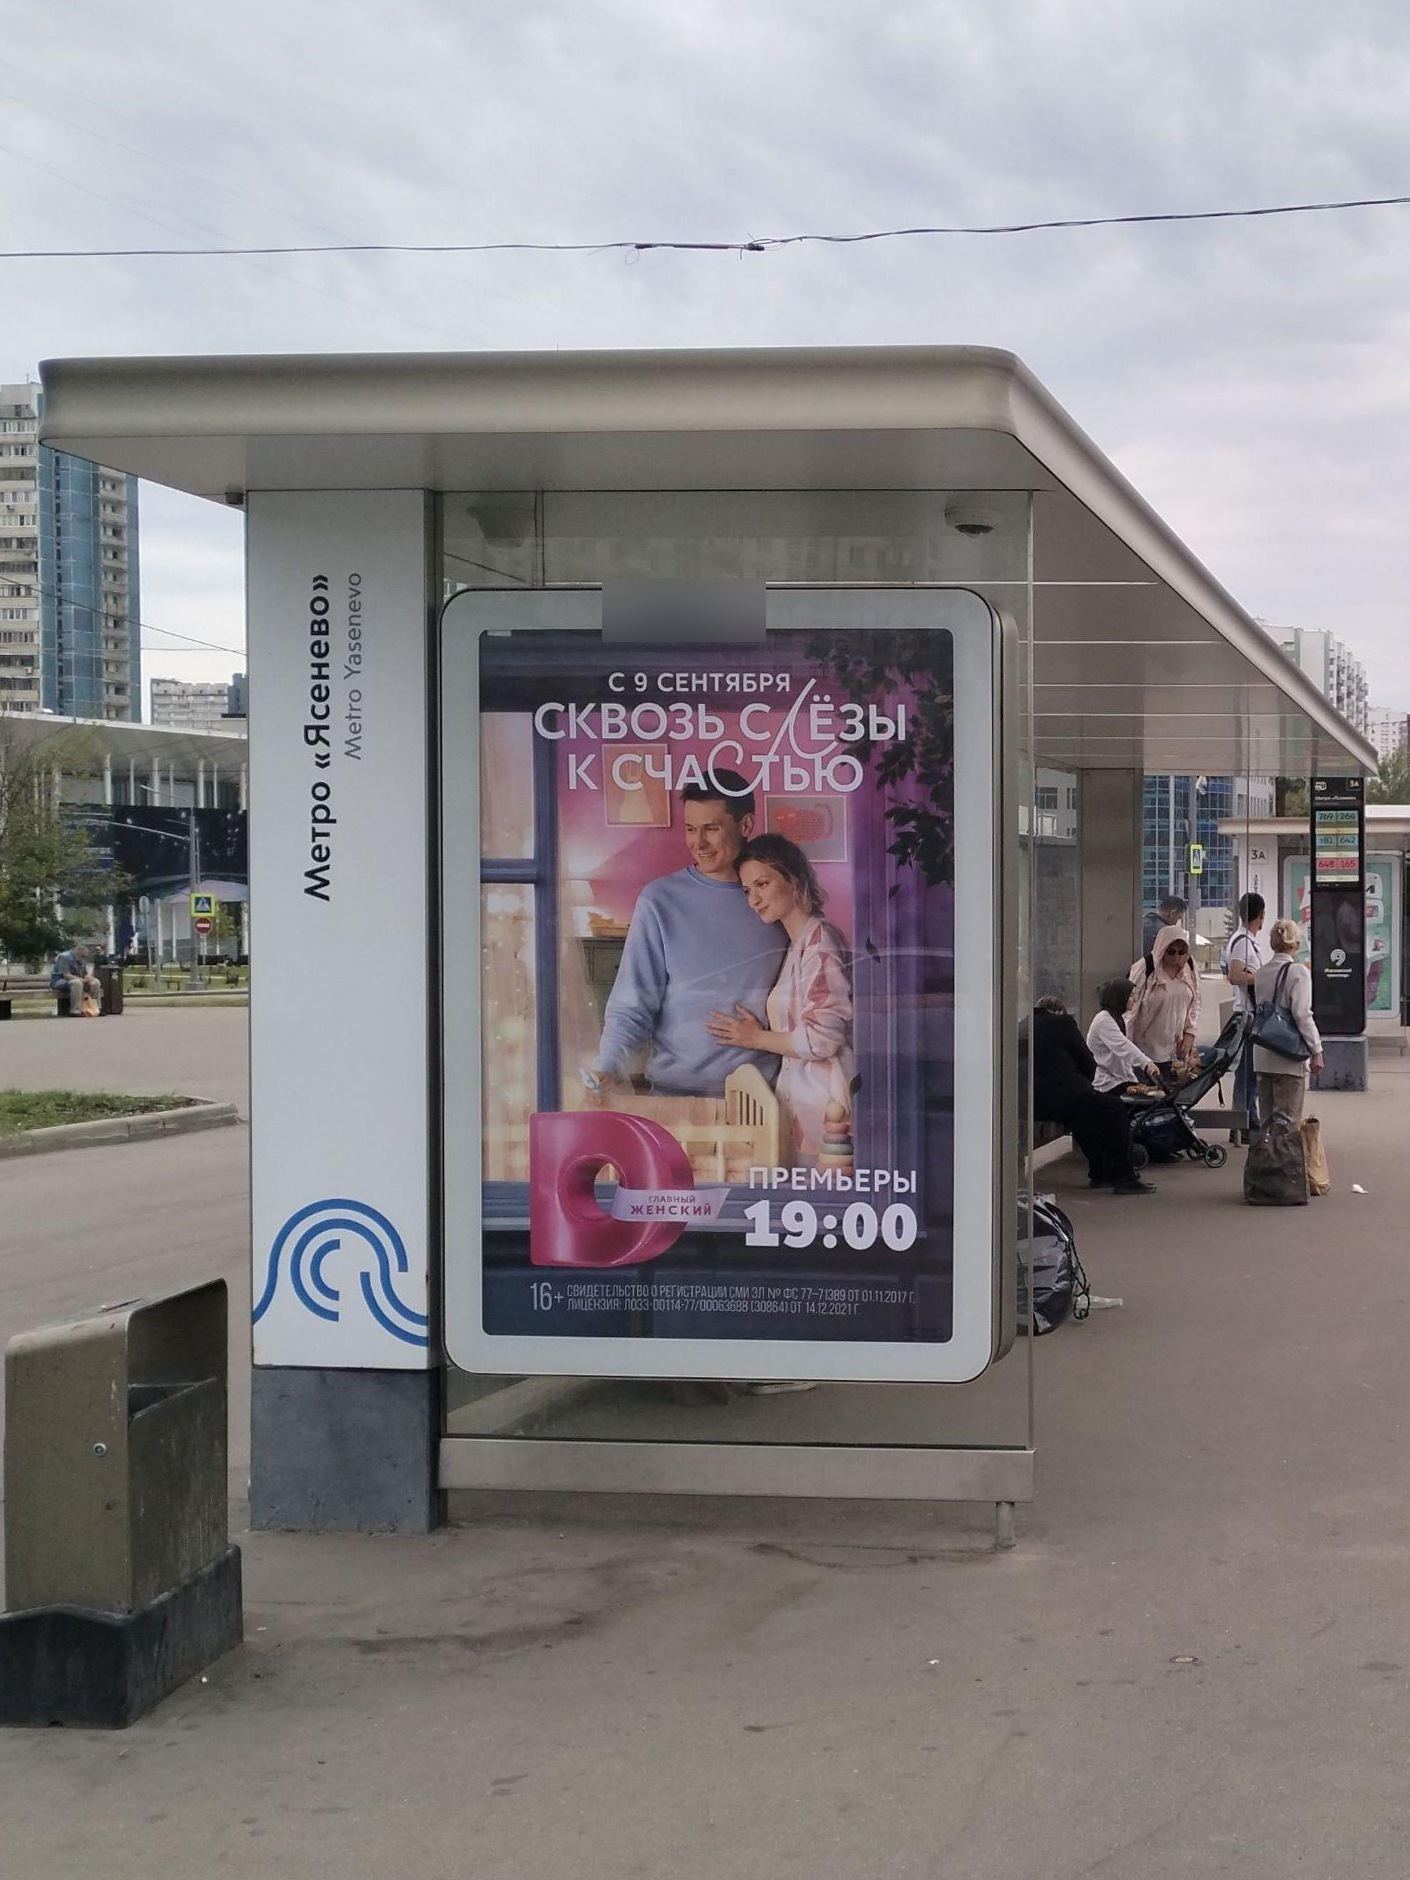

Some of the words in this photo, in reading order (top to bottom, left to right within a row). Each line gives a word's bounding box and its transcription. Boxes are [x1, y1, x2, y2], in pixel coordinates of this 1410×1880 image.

[344, 573, 362, 680] Yasenevo
[304, 574, 331, 769] «Ясенево»
[608, 672, 625, 693] С
[634, 672, 648, 692] 9
[657, 672, 791, 693] СЕНТЯБРЯ
[344, 689, 362, 760] Metro
[534, 702, 725, 740] СКВОЗЬ
[739, 679, 906, 759] СЛЁЗЫ
[568, 753, 598, 790] К
[612, 740, 864, 797] СЧАСТЬЮ
[304, 781, 337, 902] Метро
[1318, 860, 1335, 868] 648
[1341, 860, 1356, 868] 165
[750, 1166, 917, 1193] ПРЕМЬЕРЫ
[630, 1203, 712, 1216] ЖЕНСКИЙ
[648, 1195, 696, 1204] ГЛАВНЫЙ
[743, 1200, 918, 1252] 19:00
[529, 1282, 565, 1311] 16+
[566, 1284, 649, 1298] СВИДЕТЕЛЬСТВО
[651, 1285, 658, 1298] О
[659, 1284, 728, 1299] РЕГИСТРАЦИИ
[729, 1286, 750, 1298] СМИ
[767, 1287, 781, 1299] №
[783, 1287, 799, 1300] ФС
[848, 1289, 860, 1302] ОТ
[861, 1290, 907, 1303] 01.11.2017
[566, 1299, 622, 1311] ЛИЦЕНЗИЯ:
[750, 1300, 788, 1313] (30864)
[790, 1301, 802, 1314] ОТ
[805, 1302, 851, 1316] 14.12.2021
